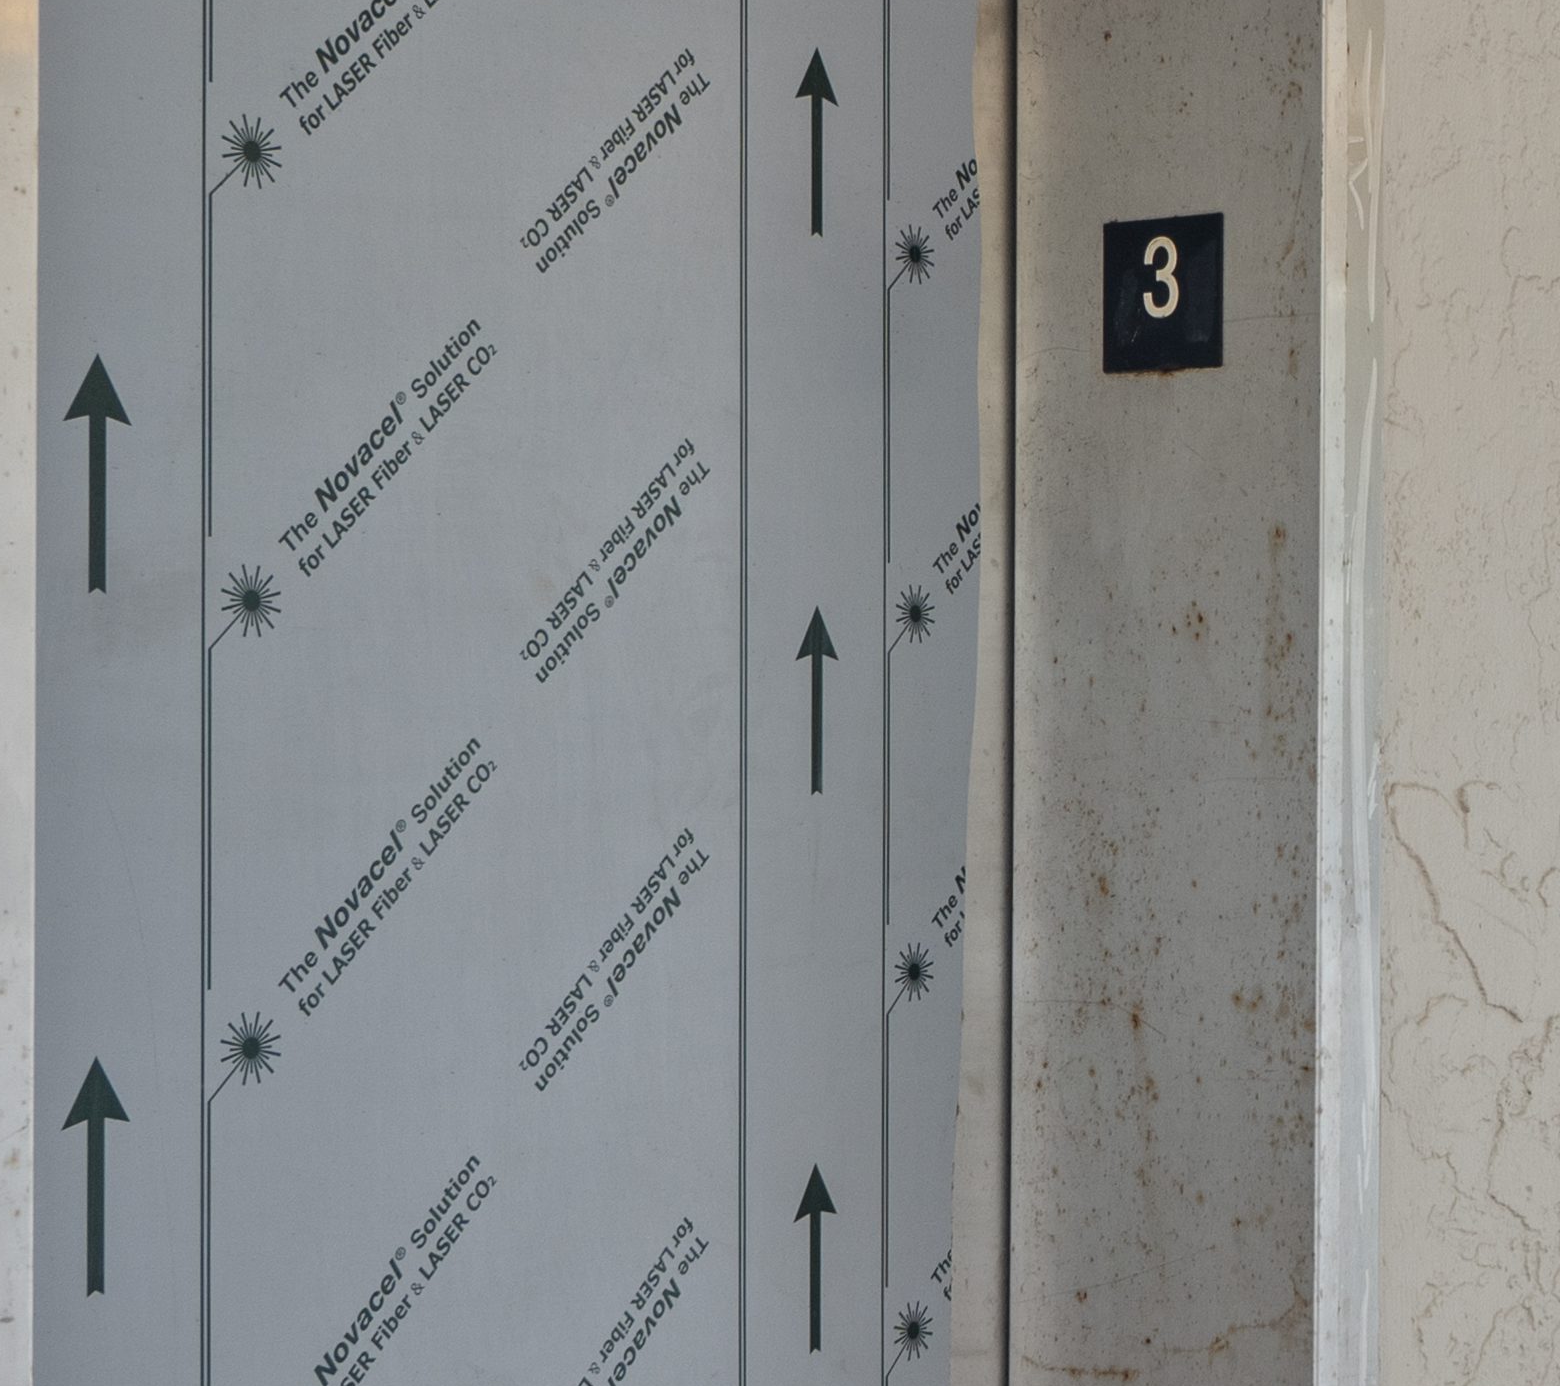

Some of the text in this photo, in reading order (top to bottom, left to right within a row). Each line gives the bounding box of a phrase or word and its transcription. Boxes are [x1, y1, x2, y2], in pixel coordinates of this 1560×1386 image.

[298, 103, 327, 136] for
[322, 52, 378, 112] LASER
[371, 12, 414, 60] Fiber
[412, 4, 427, 20] &
[673, 47, 696, 76] for
[278, 70, 320, 109] The
[631, 69, 677, 123] LASER
[679, 72, 711, 106] The
[599, 116, 636, 161] Fiber
[545, 166, 594, 222] LASER
[931, 188, 959, 219] The
[535, 198, 601, 274] Solution
[944, 215, 963, 241] for
[1143, 236, 1180, 319] 3
[418, 372, 471, 433] LASER
[277, 511, 319, 552] The
[410, 319, 482, 399] Solution
[411, 430, 426, 446] &
[673, 437, 695, 467] for
[370, 440, 413, 491] Fiber
[630, 462, 677, 520] LASER
[678, 461, 711, 496] The
[321, 486, 377, 550] LASER
[599, 515, 636, 563] Fiber
[298, 543, 326, 578] for
[931, 541, 959, 574] The
[944, 568, 963, 595] for
[545, 570, 594, 631] LASER
[534, 602, 601, 684] Solution
[277, 951, 319, 993] The
[410, 737, 482, 825] Solution
[672, 827, 695, 858] for
[677, 848, 710, 886] The
[298, 982, 326, 1017] for
[321, 918, 377, 986] LASER
[370, 867, 413, 921] Fiber
[410, 856, 426, 871] &
[418, 792, 471, 857] LASER
[630, 854, 676, 915] LASER
[931, 894, 958, 929] The
[944, 920, 962, 948] for
[598, 912, 635, 963] Fiber
[544, 973, 593, 1037] LASER
[534, 1003, 600, 1092] Solution
[410, 1155, 481, 1250] Solution
[370, 1293, 412, 1351] Fiber
[410, 1282, 425, 1296] &
[418, 1212, 470, 1281] LASER
